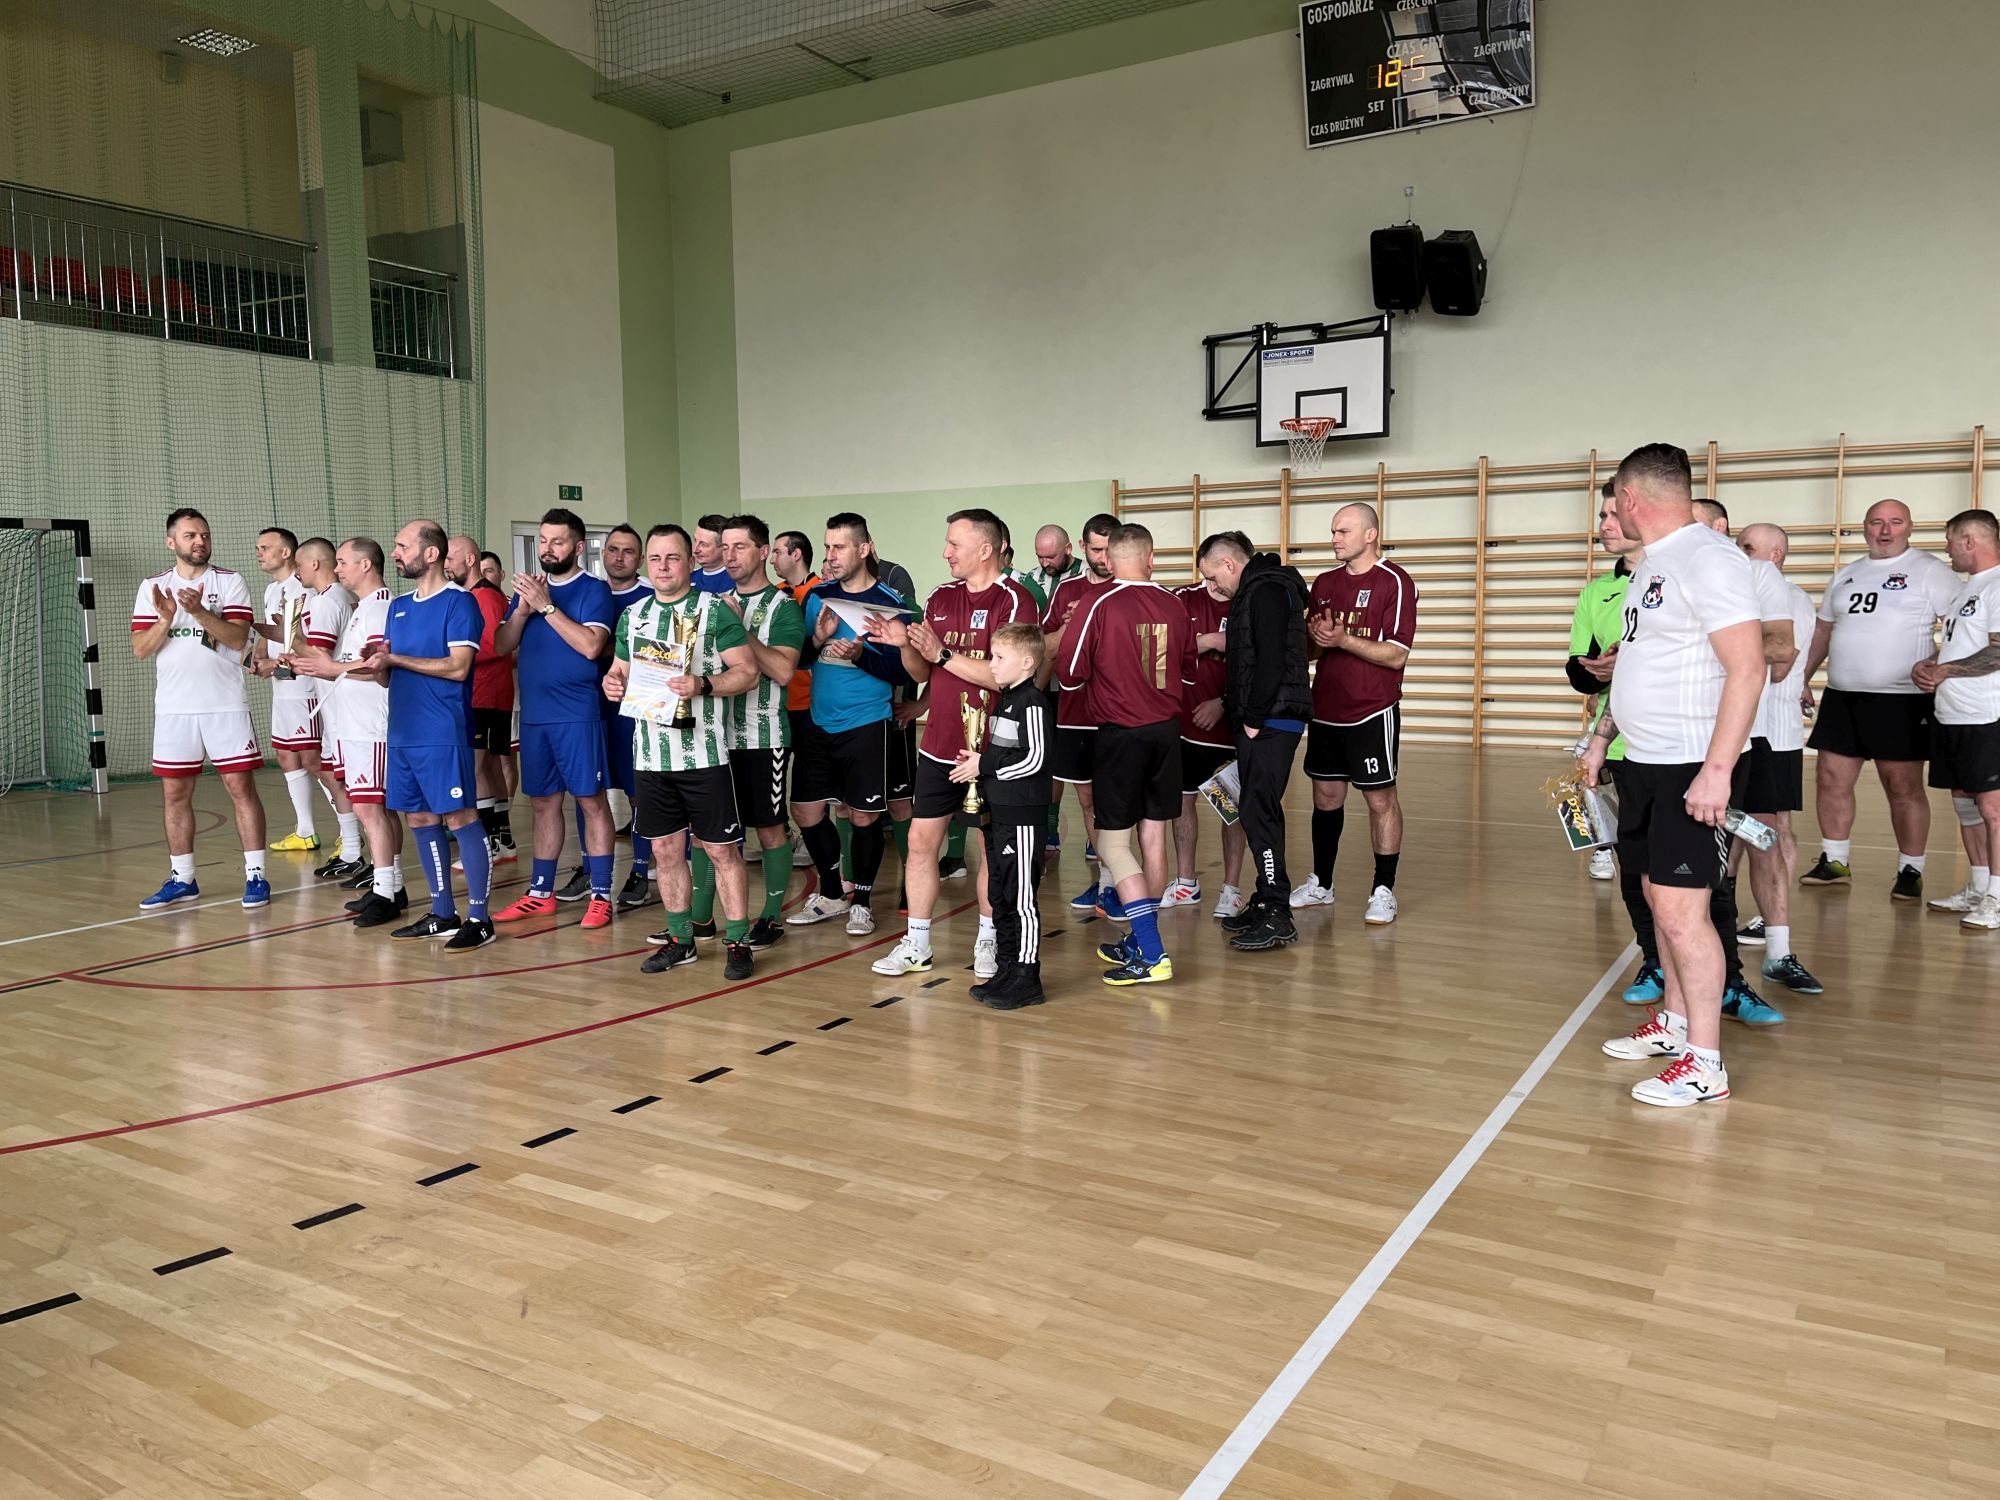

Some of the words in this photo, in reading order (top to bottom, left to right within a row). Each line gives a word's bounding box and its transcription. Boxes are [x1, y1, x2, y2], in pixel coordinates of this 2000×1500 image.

[1307, 0, 1374, 25] GOSPODARZE
[1387, 40, 1416, 59] CZAS
[1420, 34, 1444, 53] GRY
[1474, 37, 1524, 58] ZAGRYWKA
[1310, 73, 1354, 92] ZAGRYWKA
[1449, 83, 1466, 97] SET
[1367, 100, 1385, 113] SET
[1468, 92, 1489, 106] CZAS
[1310, 122, 1329, 136] CZAS
[1329, 115, 1365, 133] DRUŻYNY
[1848, 592, 1878, 614] 29
[1621, 606, 1638, 642] 12
[943, 630, 959, 646] 40
[1135, 623, 1168, 690] 11
[1364, 757, 1379, 775] 13
[1566, 797, 1590, 837] DYPLO
